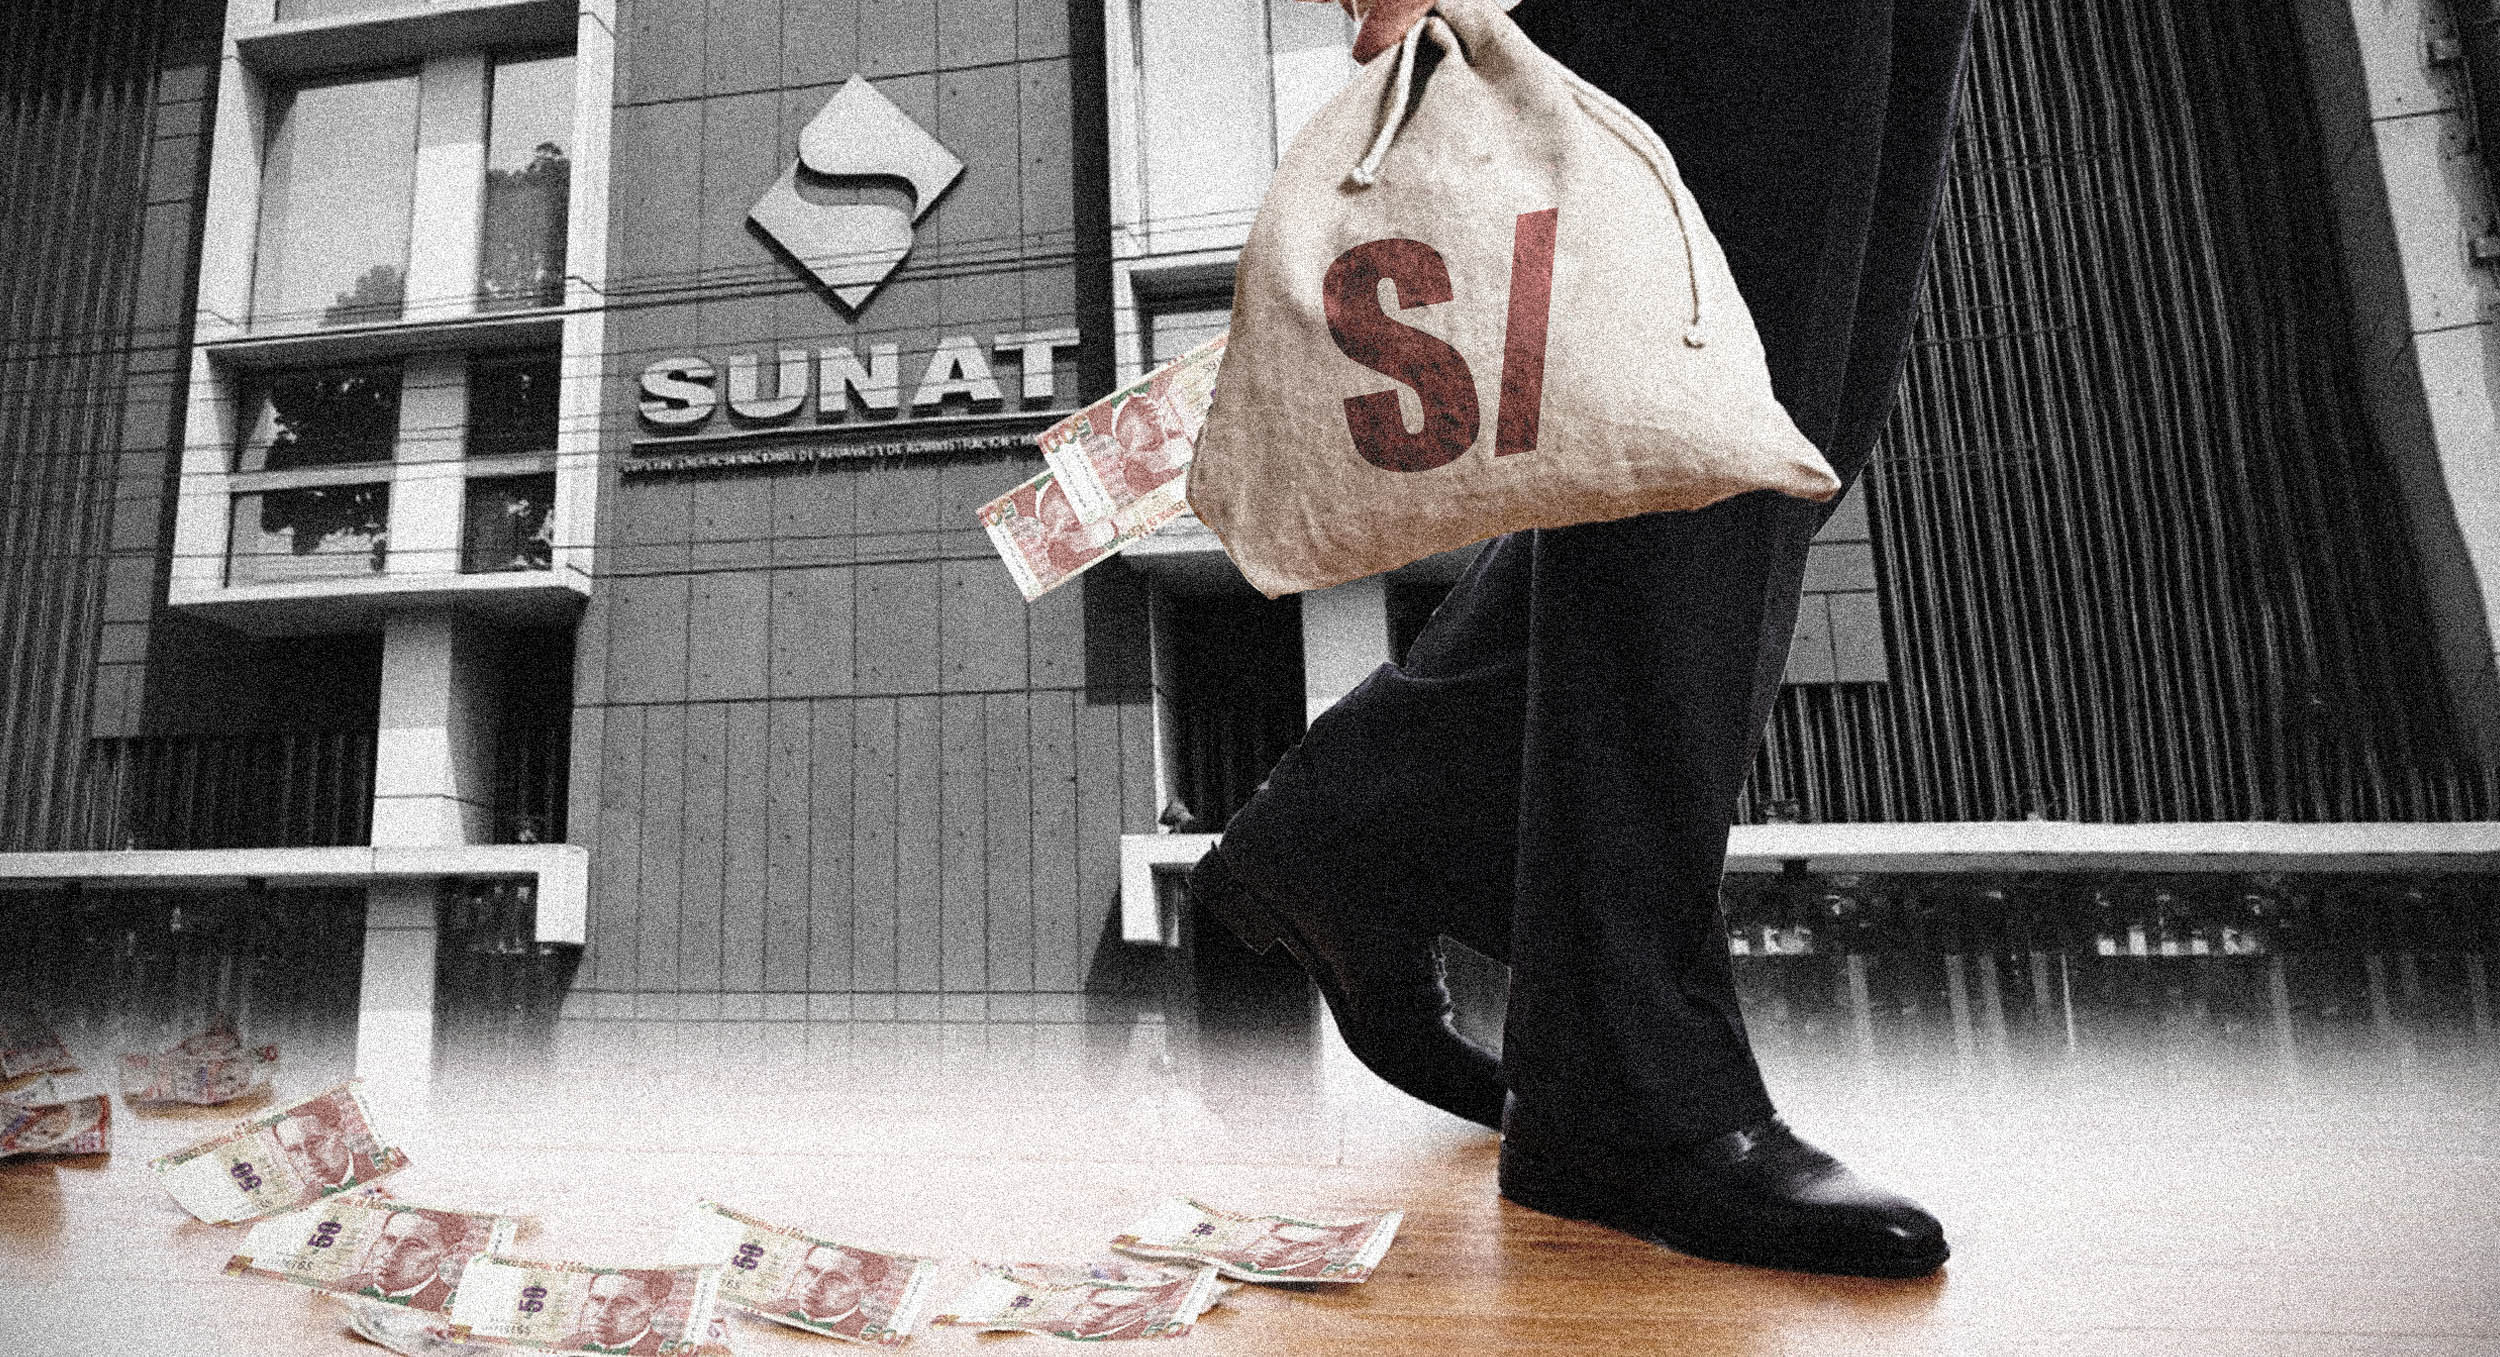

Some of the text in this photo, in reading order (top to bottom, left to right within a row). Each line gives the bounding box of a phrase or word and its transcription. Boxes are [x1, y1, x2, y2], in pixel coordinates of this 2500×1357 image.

[1323, 207, 1558, 472] S/
[639, 328, 1080, 424] SUNAT
[231, 1161, 263, 1193] 50
[308, 1219, 343, 1250] 50
[732, 1242, 766, 1271] 50
[518, 1285, 548, 1314] 50
